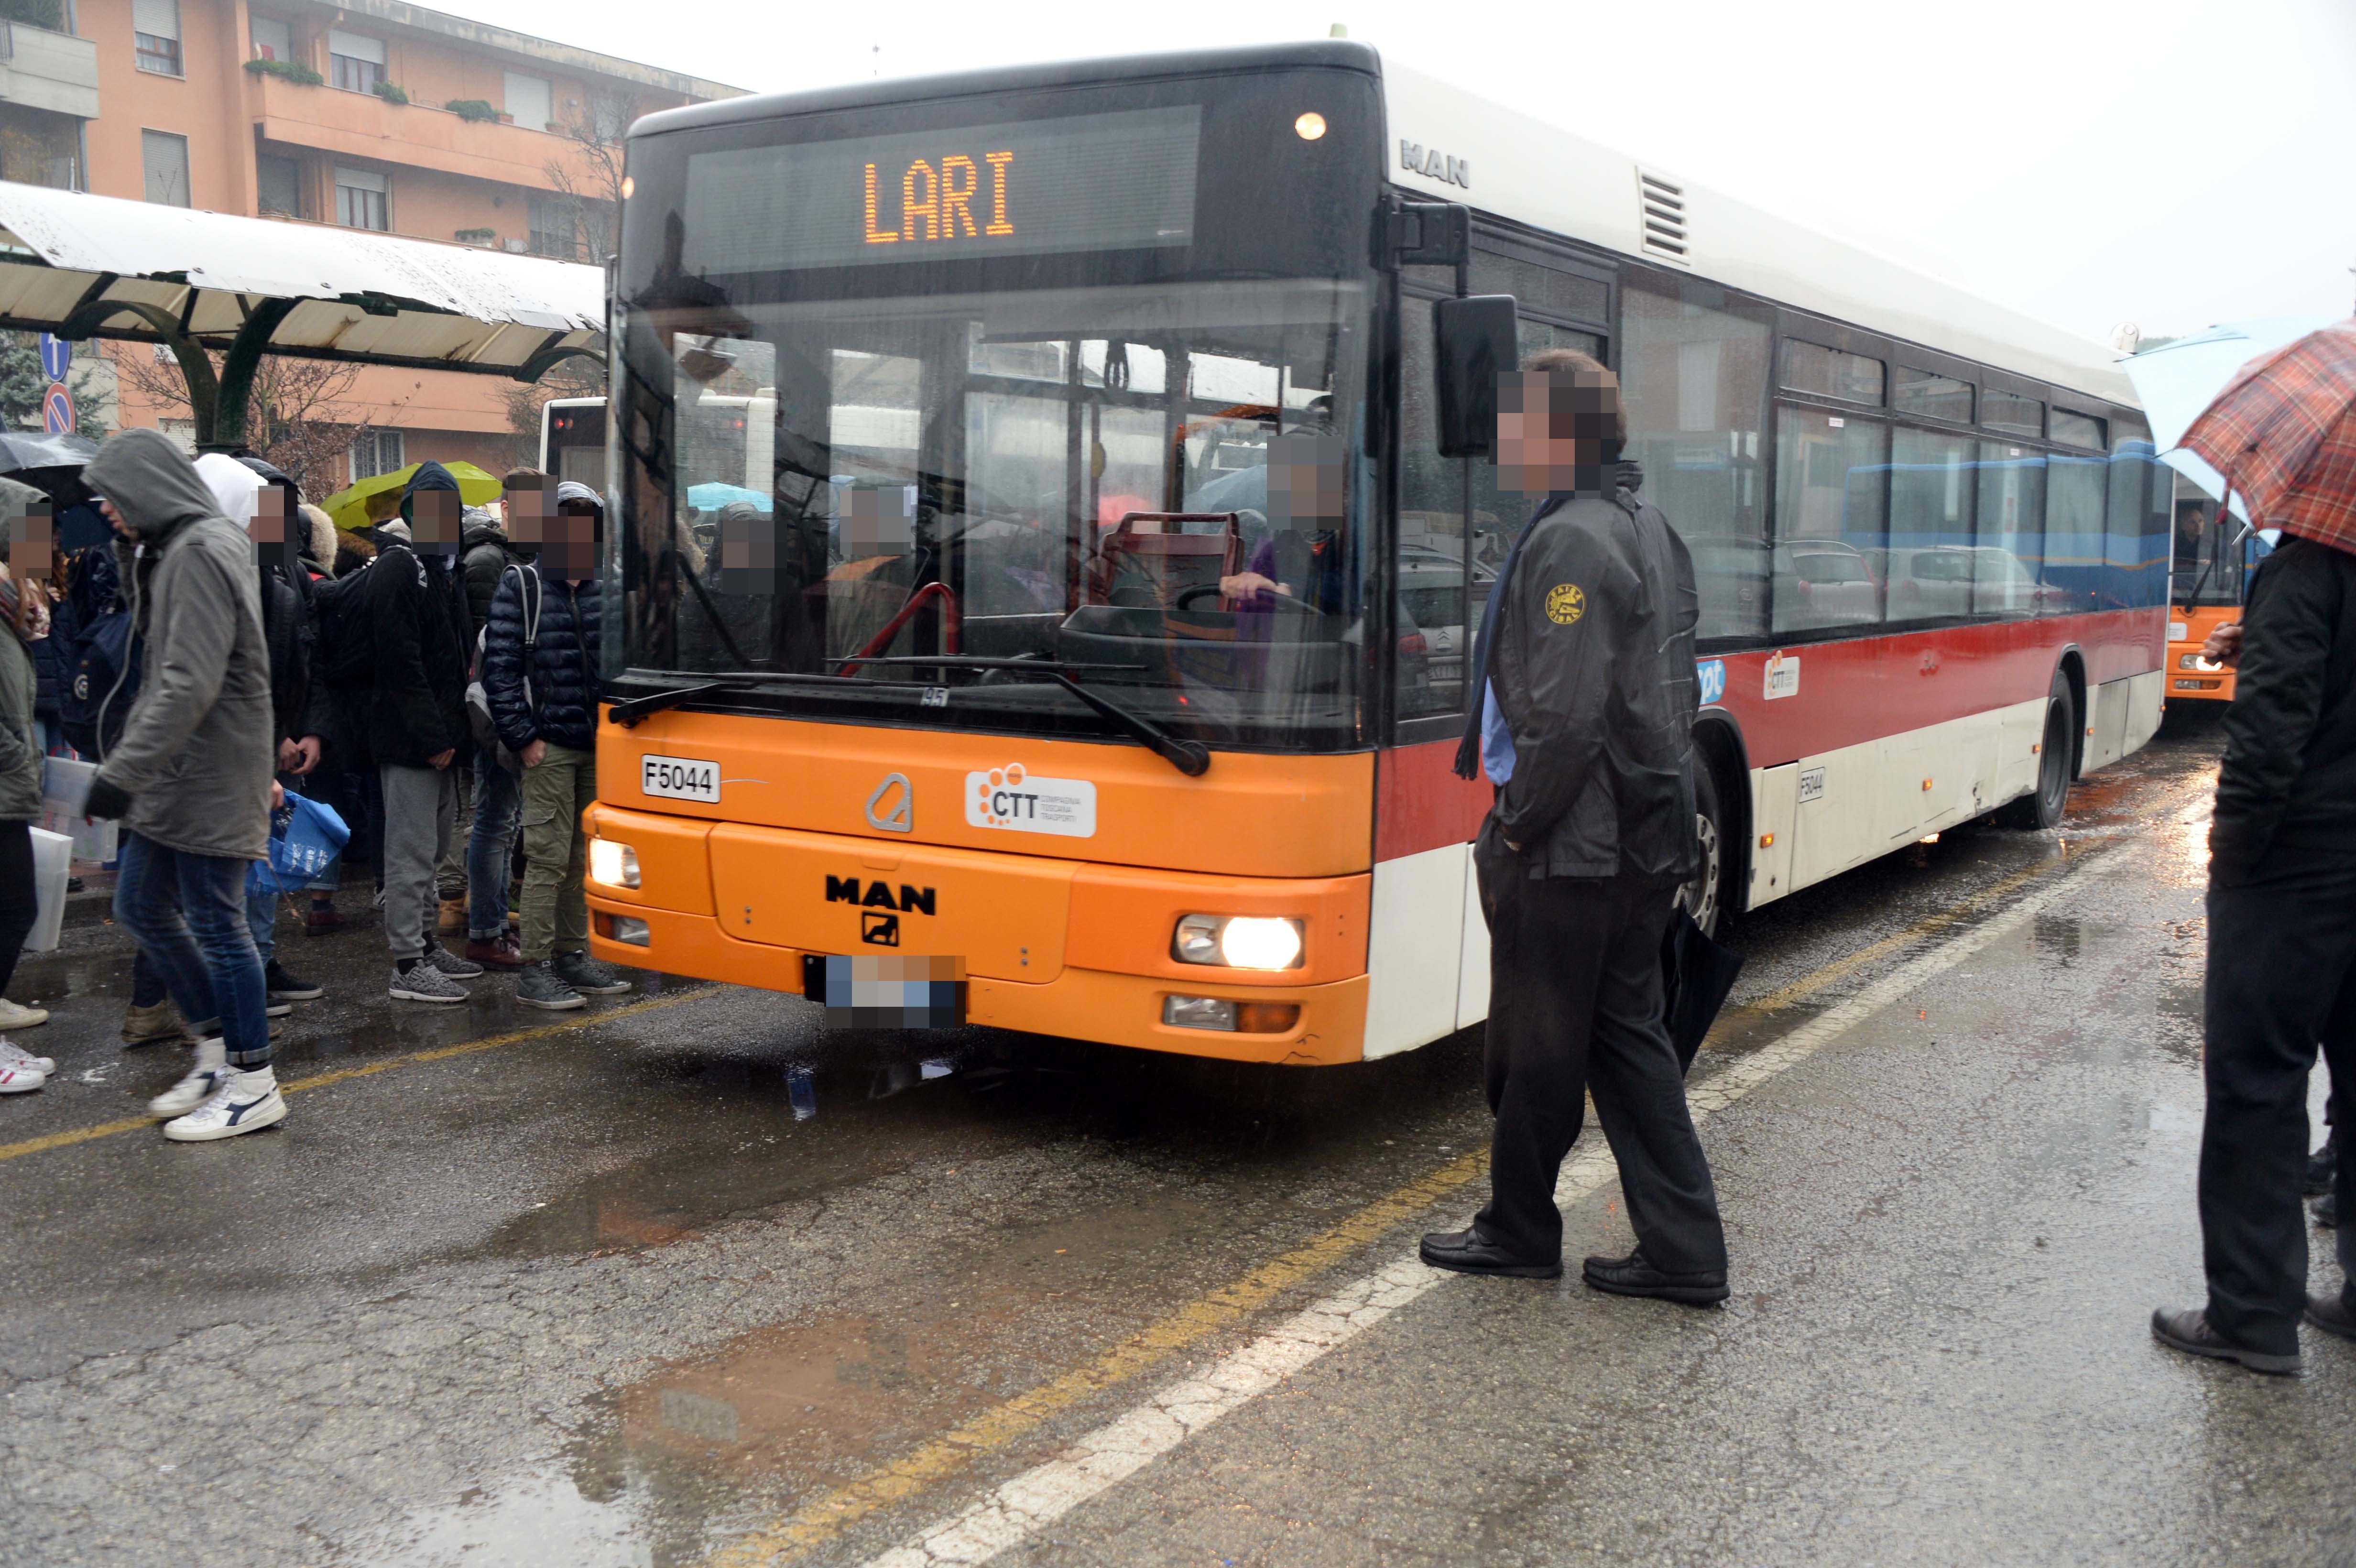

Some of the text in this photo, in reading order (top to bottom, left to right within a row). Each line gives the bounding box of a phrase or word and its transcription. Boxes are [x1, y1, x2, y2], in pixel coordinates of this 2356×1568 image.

[1400, 139, 1469, 189] MAN
[865, 151, 1013, 243] LARI
[1772, 671, 1784, 689] CTT
[646, 762, 712, 794] F5044
[1800, 774, 1822, 795] F5044
[993, 791, 1038, 818] CTT
[1040, 795, 1081, 804] COMPAGNIA
[1040, 804, 1072, 813] TOSCANA
[1040, 813, 1077, 822] TRASPORTI
[826, 874, 935, 915] MAN
